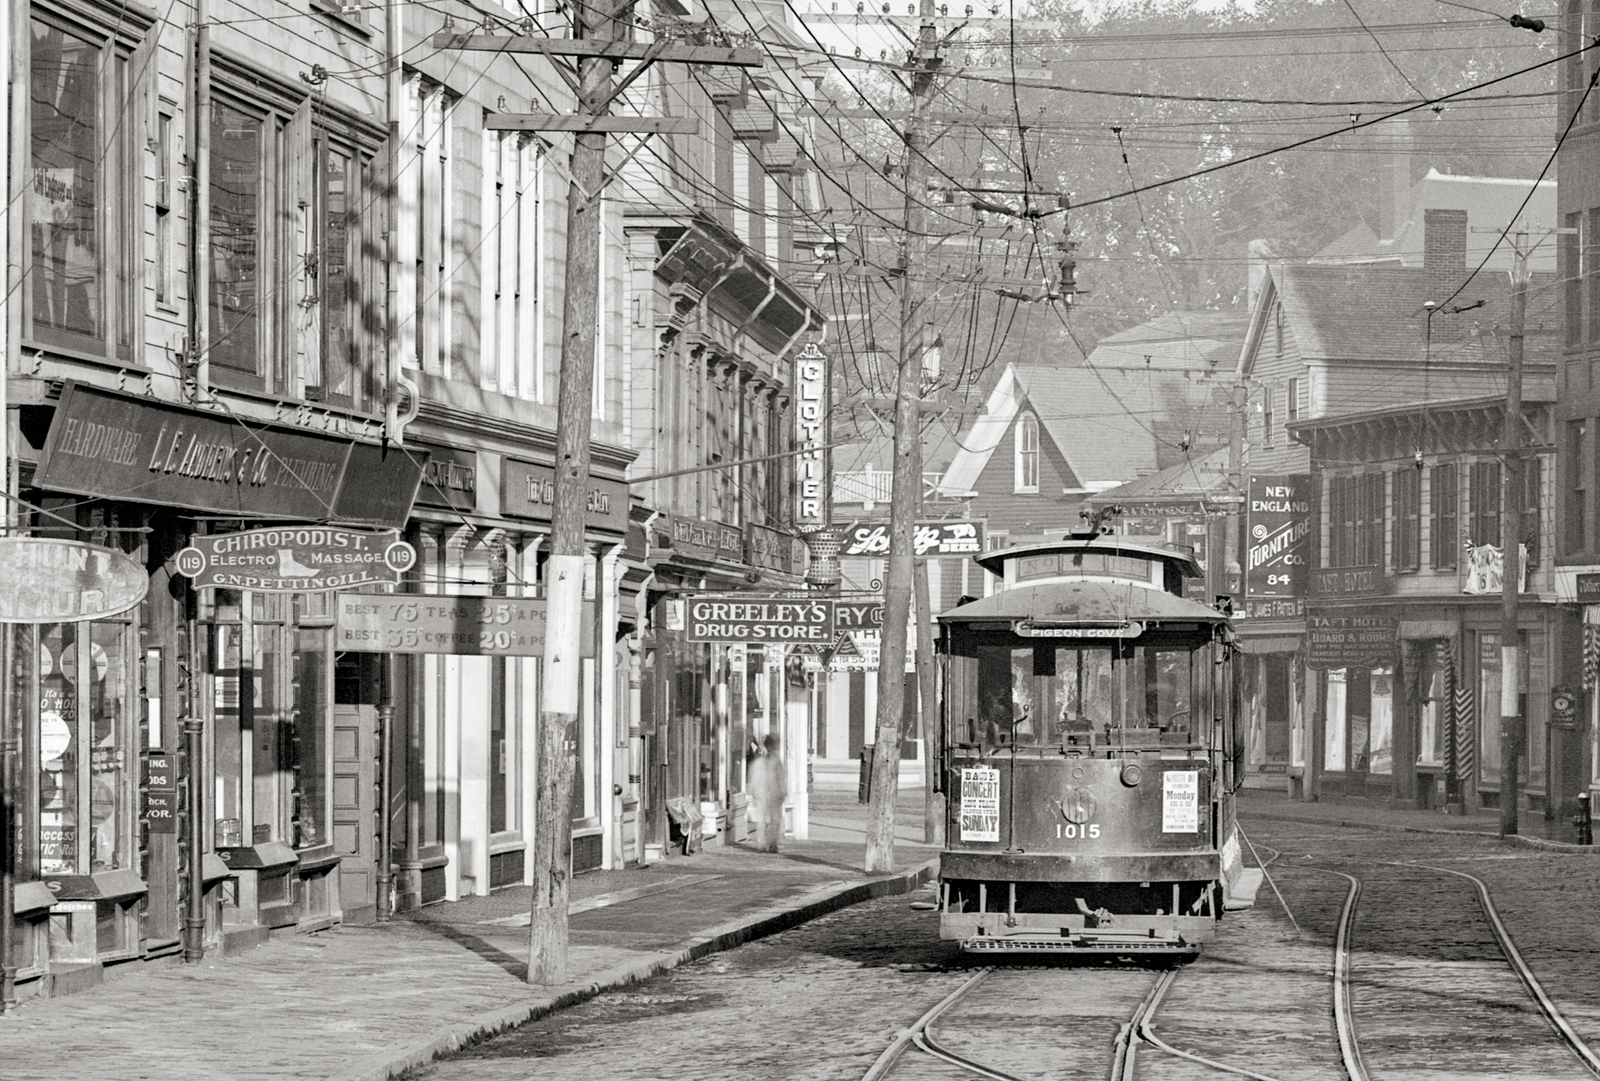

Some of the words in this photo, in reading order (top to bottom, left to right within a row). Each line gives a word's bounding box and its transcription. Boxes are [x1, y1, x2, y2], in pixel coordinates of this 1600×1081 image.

[802, 363, 820, 518] CLOTHIER
[1265, 486, 1296, 497] NEW
[1252, 500, 1309, 512] ENGLAND
[213, 530, 369, 554] CHIROPODIST.
[1249, 517, 1310, 571] FURNITURE
[182, 558, 200, 569] 119
[210, 554, 276, 566] ELECTRO
[392, 550, 409, 562] 119
[1283, 554, 1305, 565] CO.
[1267, 574, 1291, 586] 84
[345, 604, 380, 615] BEST
[426, 606, 468, 618] TEAS
[692, 600, 827, 622] GREELEY'S
[1312, 617, 1349, 628] TAFT
[345, 629, 380, 641] BEST
[424, 632, 475, 644] COFFEE
[694, 623, 750, 637] DRUG
[752, 624, 829, 639] STORE.
[1030, 628, 1082, 638] PIGEON
[1087, 628, 1125, 638] COVE
[1312, 632, 1345, 643] BOARD
[1348, 632, 1357, 643] &
[1360, 632, 1394, 643] ROOMS
[45, 689, 57, 698] It's
[963, 781, 998, 798] CONCERT
[1166, 790, 1196, 801] Monday
[962, 815, 998, 832] SUNDAY
[1056, 824, 1101, 839] 1015
